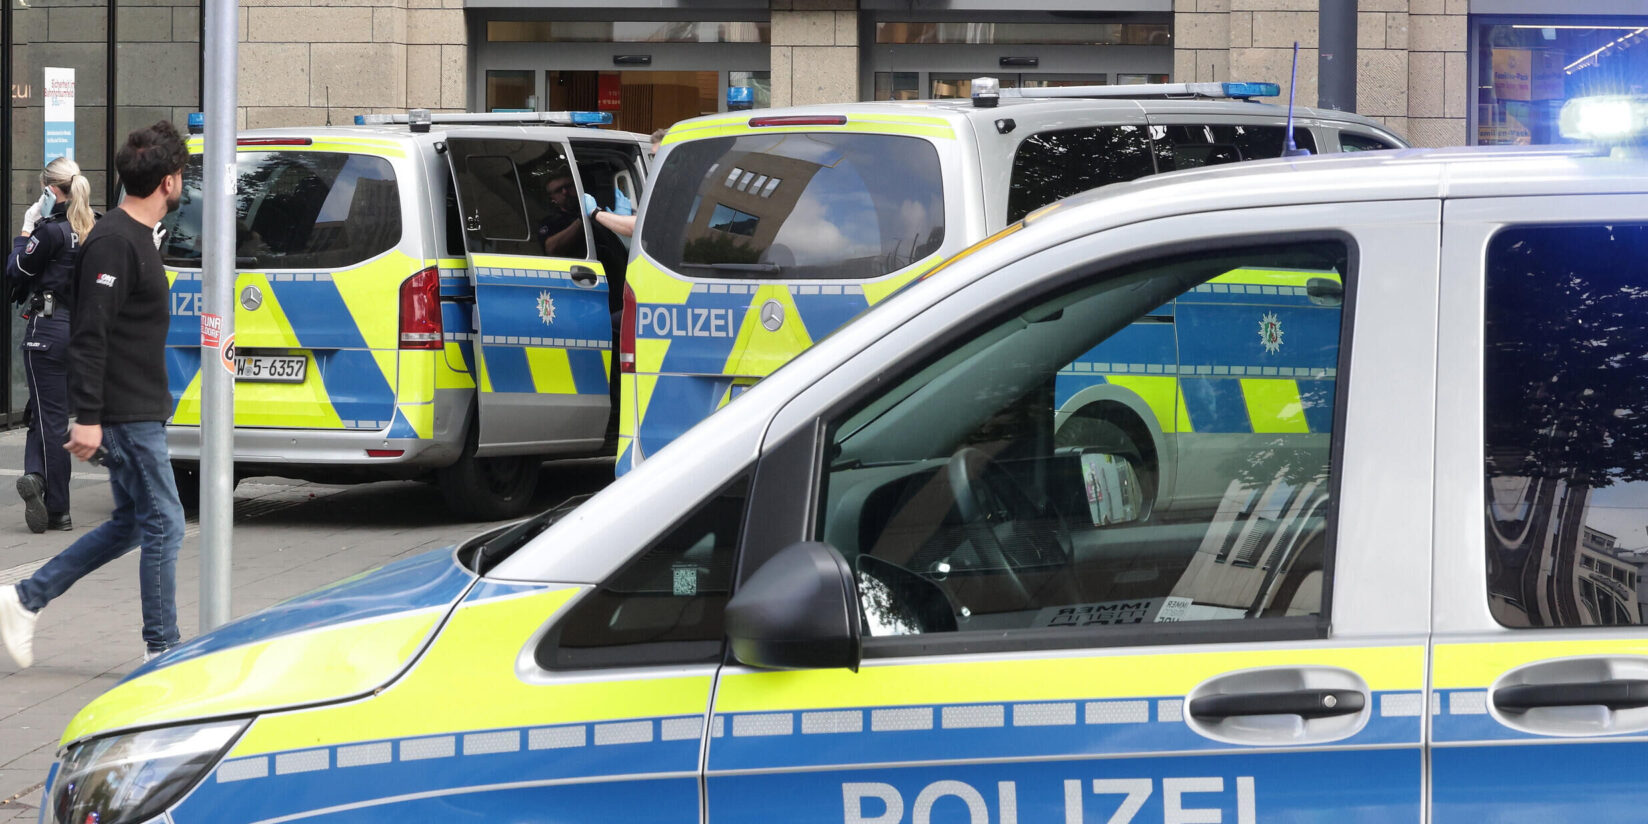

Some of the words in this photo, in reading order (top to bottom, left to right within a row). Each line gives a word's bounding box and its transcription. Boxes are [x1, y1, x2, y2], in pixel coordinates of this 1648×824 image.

[170, 292, 203, 316] IZE
[638, 306, 734, 338] POLIZEI
[235, 358, 247, 376] W
[253, 359, 304, 377] 5-6357
